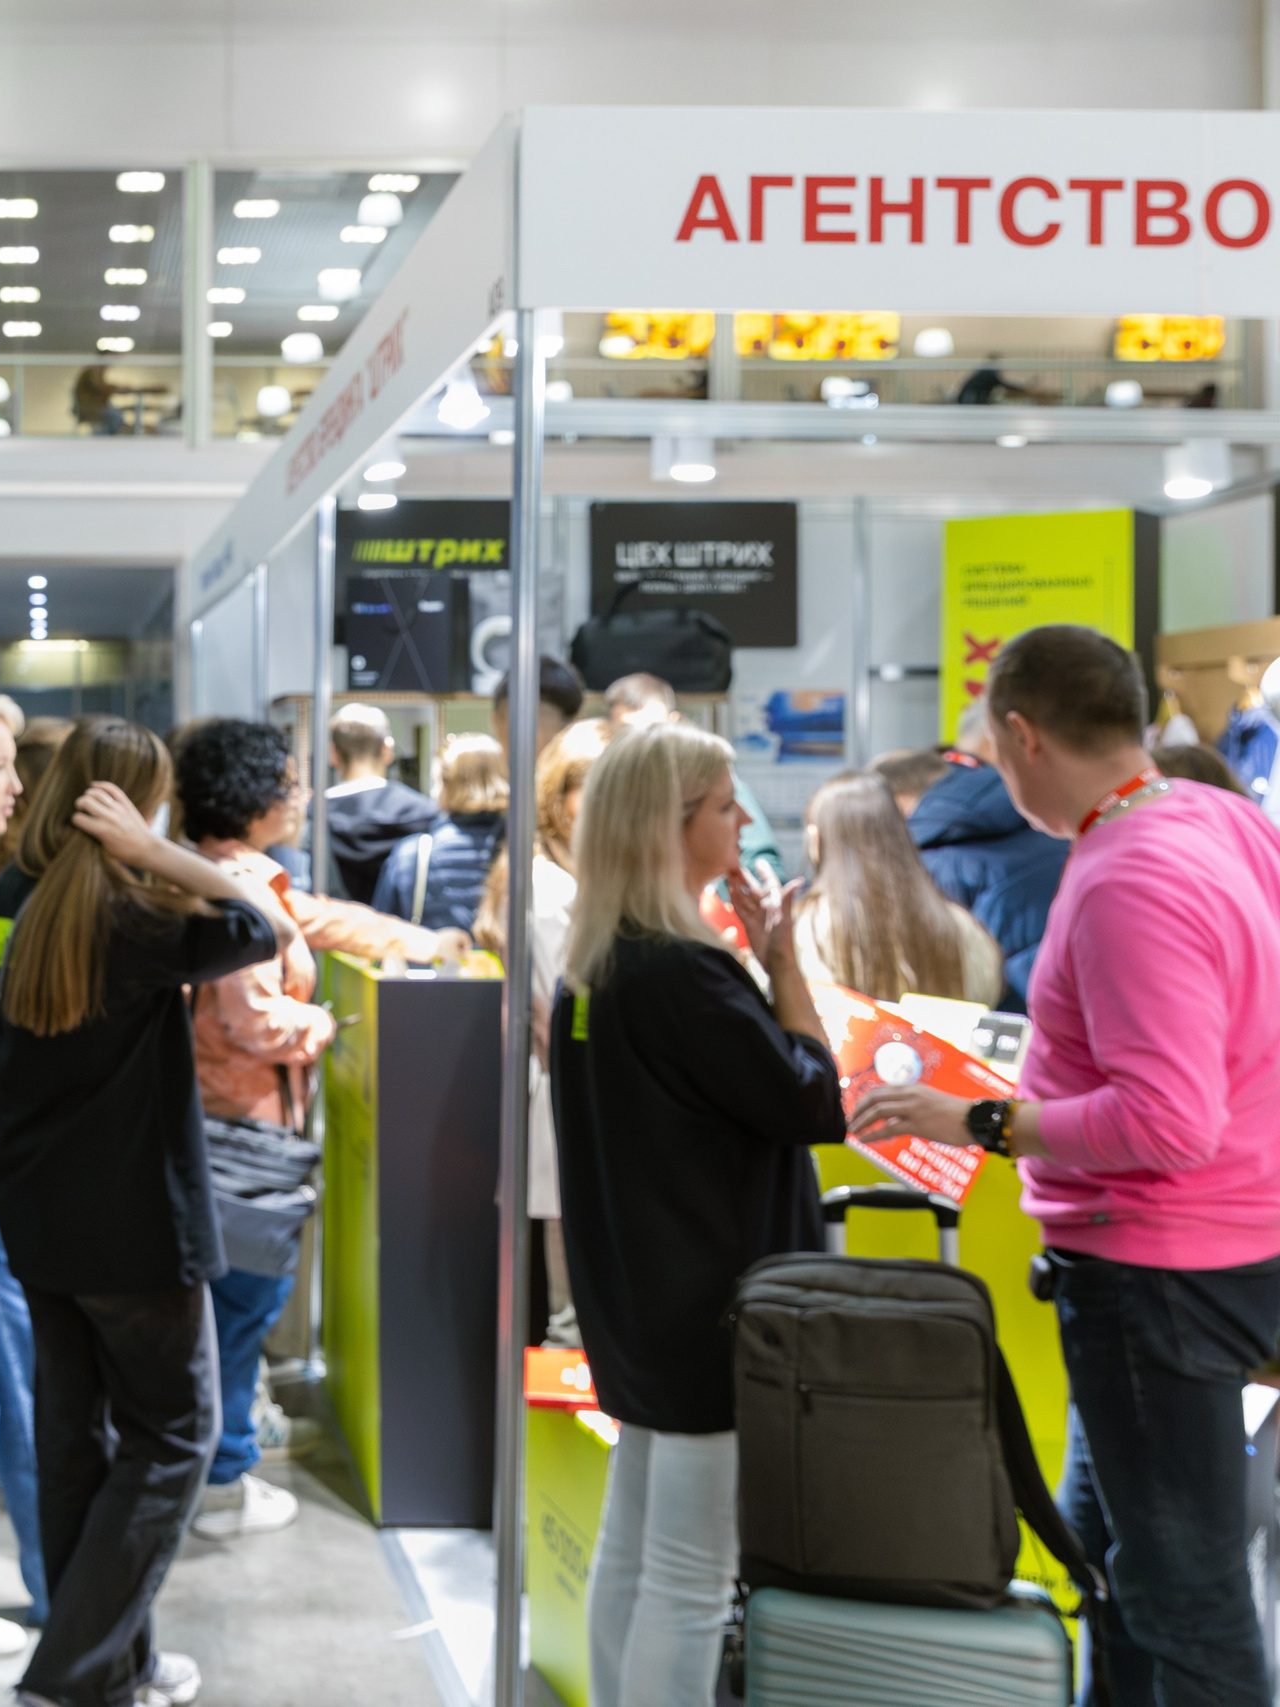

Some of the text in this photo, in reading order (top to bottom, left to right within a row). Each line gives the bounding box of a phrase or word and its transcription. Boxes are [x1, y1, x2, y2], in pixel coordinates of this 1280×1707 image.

[675, 174, 1272, 249] АГЕНТСТВО
[615, 541, 775, 568] ЦЕХ ШТРИХ
